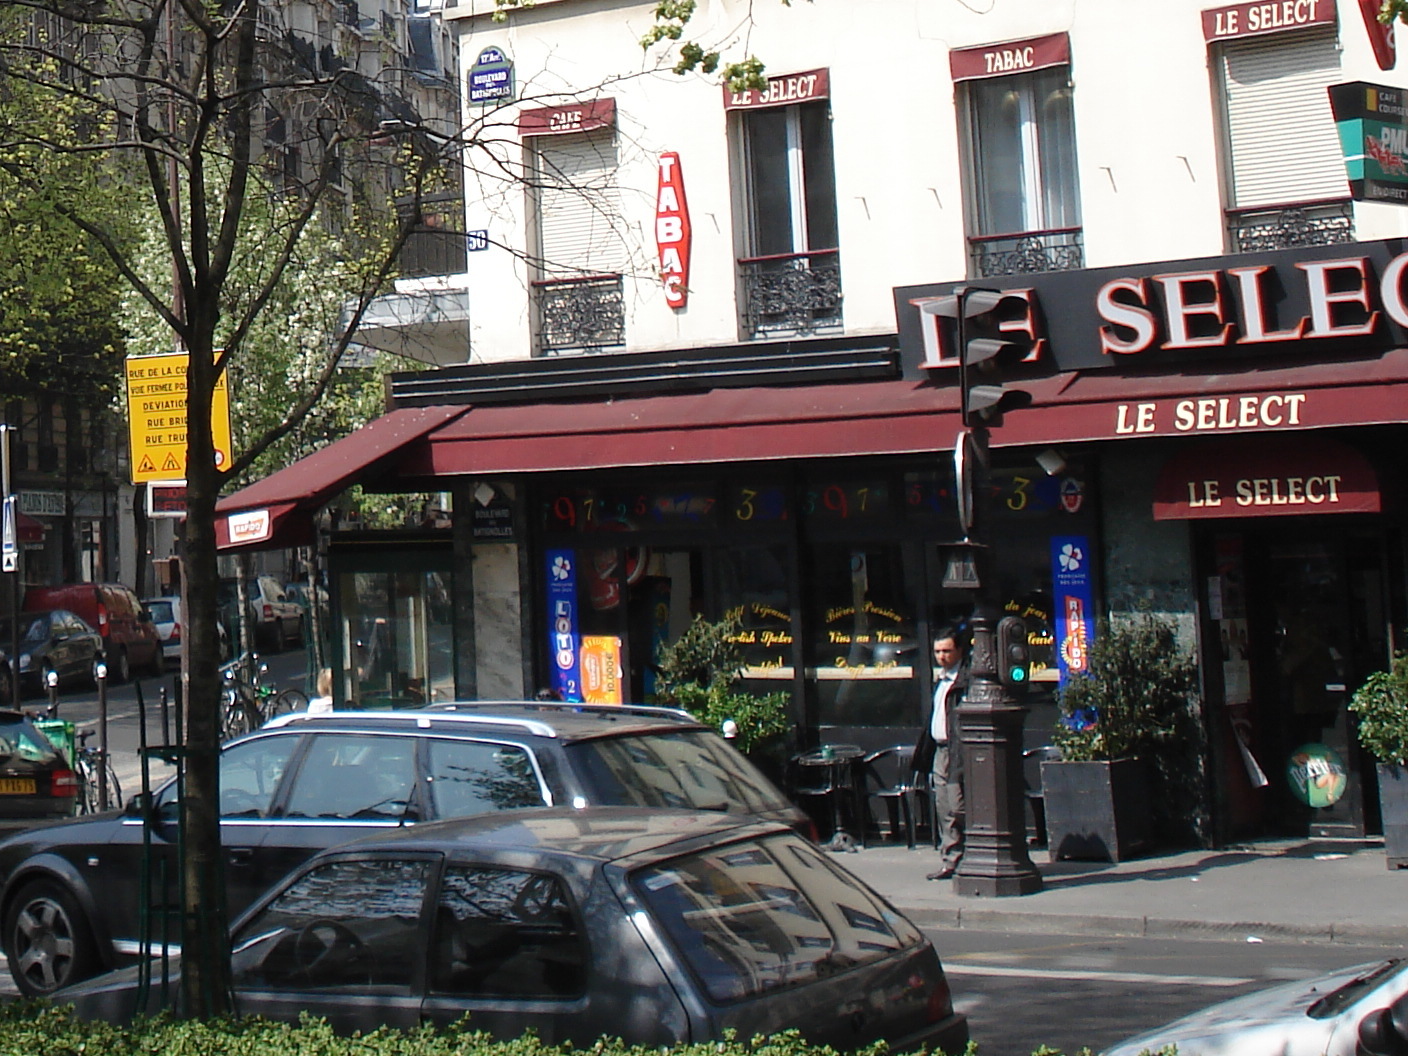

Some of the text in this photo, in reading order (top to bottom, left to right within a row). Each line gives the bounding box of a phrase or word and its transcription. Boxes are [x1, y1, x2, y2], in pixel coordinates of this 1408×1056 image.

[1215, 9, 1239, 36] LE
[985, 47, 1035, 74] TABAC
[759, 74, 817, 104] SELECT
[656, 156, 683, 302] TABAC
[129, 369, 143, 378] RUE
[148, 367, 159, 377] DE
[161, 366, 173, 375] LA
[143, 399, 188, 411] DEVIATIO
[1116, 393, 1306, 434] LE SELECT
[147, 418, 165, 427] RUE
[145, 433, 188, 444] RUE TRU
[736, 489, 757, 521] 3
[1006, 476, 1030, 511] 3
[1189, 475, 1341, 508] LE SELECT
[556, 601, 574, 670] LOTO
[828, 630, 851, 644] Vins
[1069, 600, 1082, 669] RAPIDO
[567, 680, 576, 694] 2
